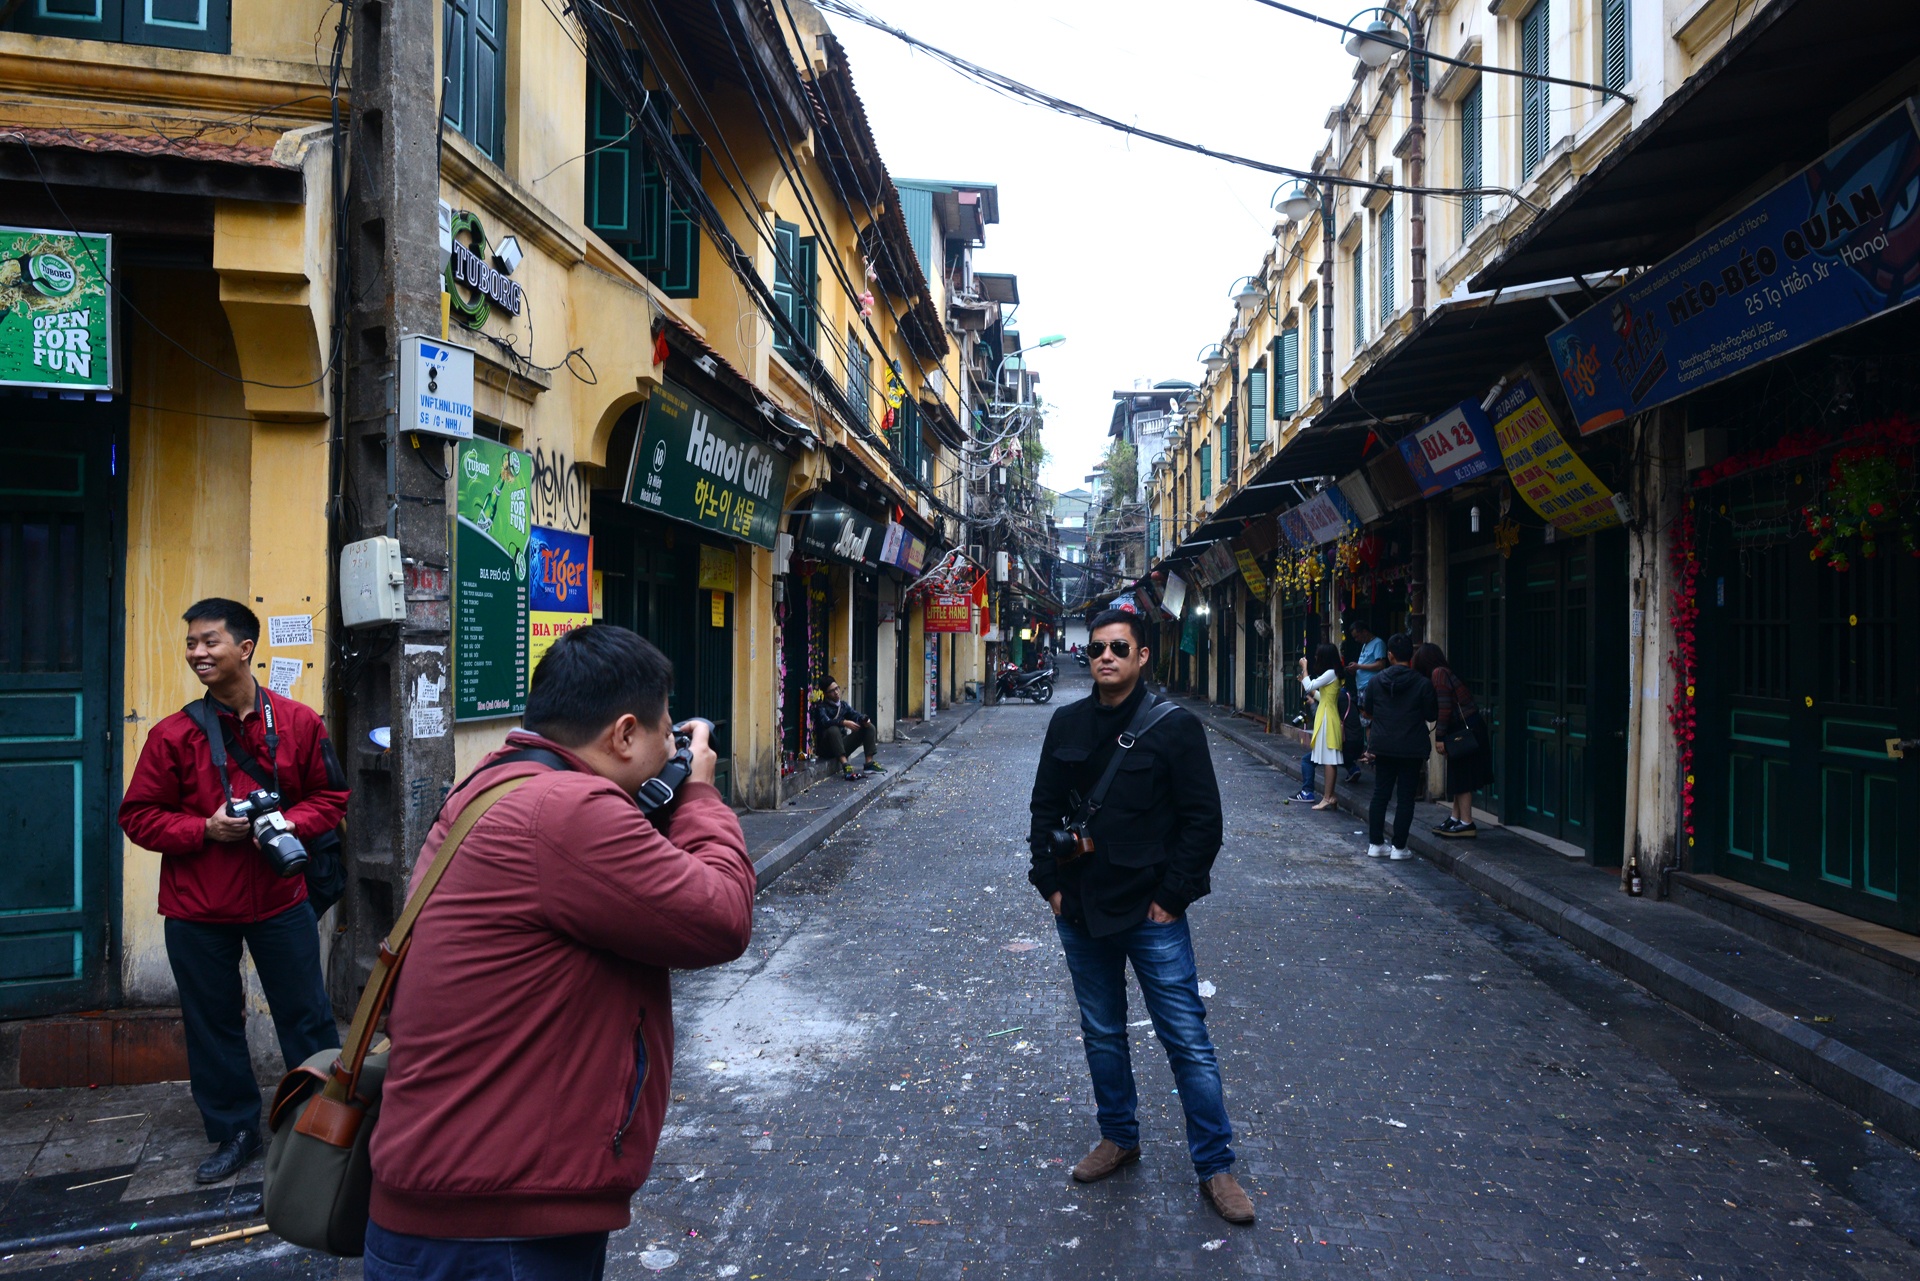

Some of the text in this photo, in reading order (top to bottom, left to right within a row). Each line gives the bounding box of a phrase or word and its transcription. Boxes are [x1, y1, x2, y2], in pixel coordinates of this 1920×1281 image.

[1708, 242, 1720, 254] the
[1719, 230, 1738, 247] heart
[1746, 209, 1769, 233] Hanoi
[1666, 184, 1884, 327] MÈO-BÉO QUÁN
[41, 264, 71, 279] TUBORG
[454, 240, 521, 317] TUBORG
[1745, 293, 1764, 316] 25
[1762, 287, 1782, 309] Tạ
[1780, 265, 1813, 297] Hiền
[1812, 262, 1830, 281] Str
[1840, 227, 1890, 267] Hanoi
[33, 309, 90, 330] OPEN
[33, 329, 91, 353] FOR
[1753, 335, 1769, 351] and
[1769, 328, 1788, 343] more
[33, 348, 91, 378] FUN
[425, 362, 445, 371] VNPT
[1563, 343, 1601, 397] Tiger
[1421, 431, 1454, 461] BIA
[1451, 421, 1474, 447] 23
[655, 448, 664, 466] 18
[686, 409, 774, 499] Hanoi Gift
[467, 458, 490, 476] TUBORG
[510, 488, 526, 502] OPEN
[510, 501, 526, 518] FOR
[694, 478, 755, 536] 하노이 선물
[510, 514, 526, 535] FUN
[480, 568, 489, 579] BIA
[490, 567, 501, 581] PHỐ
[541, 547, 585, 602] Tiger
[544, 586, 555, 594] SINCE
[927, 606, 968, 619] LITTLE HANOI
[532, 623, 550, 637] BIA
[264, 704, 273, 728] Canon
